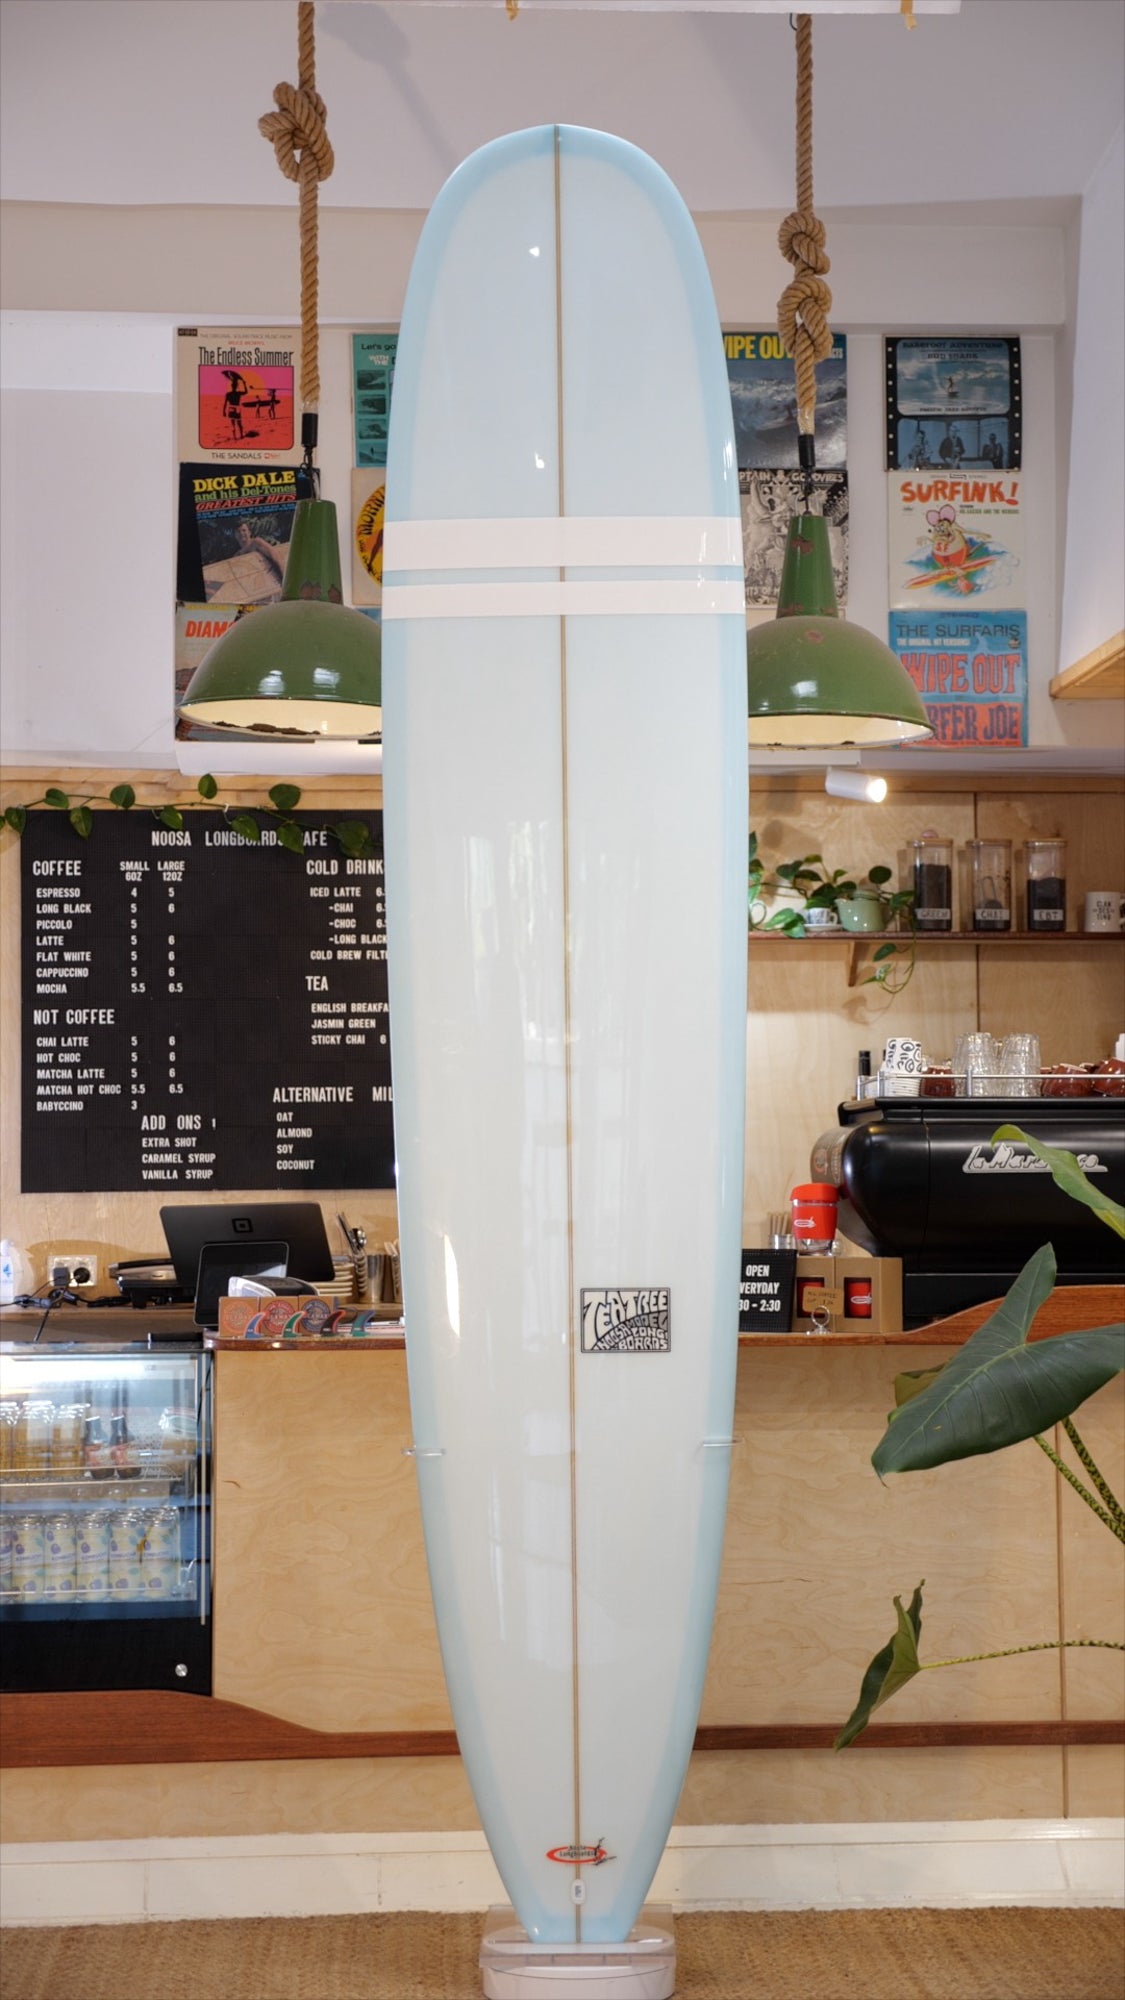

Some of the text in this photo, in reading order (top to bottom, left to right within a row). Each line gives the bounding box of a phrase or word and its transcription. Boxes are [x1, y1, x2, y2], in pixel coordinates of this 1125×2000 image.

[724, 335, 756, 359] IPE
[199, 346, 294, 367] The Endless Summer
[193, 471, 296, 493] DICK DALE
[739, 472, 771, 481] PTAIN
[194, 485, 297, 502] and his Del-Tones
[900, 480, 1019, 505] SURFINK!
[195, 497, 263, 512] GREATEST
[266, 494, 297, 504] HITS
[897, 625, 1020, 637] THE SURFARIS
[901, 652, 1021, 694] WIPE OUT
[983, 704, 1018, 740] JOE
[152, 831, 328, 847] NOOSA LONGBRD AFE
[33, 861, 81, 875] COFFEE
[120, 861, 150, 871] SMALL
[158, 861, 185, 871] LARGE
[307, 859, 383, 875] COLD DRINK
[36, 887, 174, 898] ESPRESSO 4 5
[310, 887, 385, 897] ICED LATTE 6.
[37, 903, 174, 914] LONG BLACK 5 6
[329, 903, 386, 913] -CHAI 6.
[37, 919, 137, 929] PICCOLO 5
[329, 919, 356, 928] -CHOC
[36, 935, 175, 946] LATTE 5 6
[329, 934, 387, 945] -LONG BLACK
[37, 951, 175, 962] FLAT WHITE 5 6
[310, 950, 388, 960] COLD BREW FILT
[36, 967, 175, 977] CAPPUCCINO 5 6
[37, 983, 183, 993] MOCHA 5.5 6.5
[305, 976, 328, 991] TEA
[311, 1003, 389, 1013] ENGLISH BREAKFA
[34, 1009, 114, 1025] NOT COFFEE
[312, 1019, 376, 1028] JASMIN GREEN
[37, 1036, 175, 1047] CHAI LATTE 5 6
[312, 1034, 386, 1045] STICKY CHAI 6
[37, 1052, 175, 1063] HOT CHOC 5 6
[37, 1068, 175, 1079] MATCHA LATTE 5 6
[37, 1084, 183, 1095] MATCHA HOT CHOC 5.5 6.5
[273, 1087, 393, 1102] ALTERNATIVE MIL
[37, 1100, 137, 1111] BABYCCINO 3
[141, 1115, 165, 1130] ADD
[177, 1115, 201, 1130] ONS
[277, 1112, 293, 1122] OAT
[277, 1128, 312, 1138] ALMOND
[142, 1137, 196, 1147] EXTRA SHOT
[277, 1144, 293, 1154] SOY
[142, 1153, 216, 1163] CARAMEL SYRUP
[277, 1160, 314, 1170] COCONUT
[142, 1169, 213, 1179] VANILLA SYRUP
[746, 1265, 770, 1277] OPEN
[740, 1282, 780, 1294] VERYDAY
[739, 1300, 750, 1311] 30
[760, 1300, 781, 1312] 2:30
